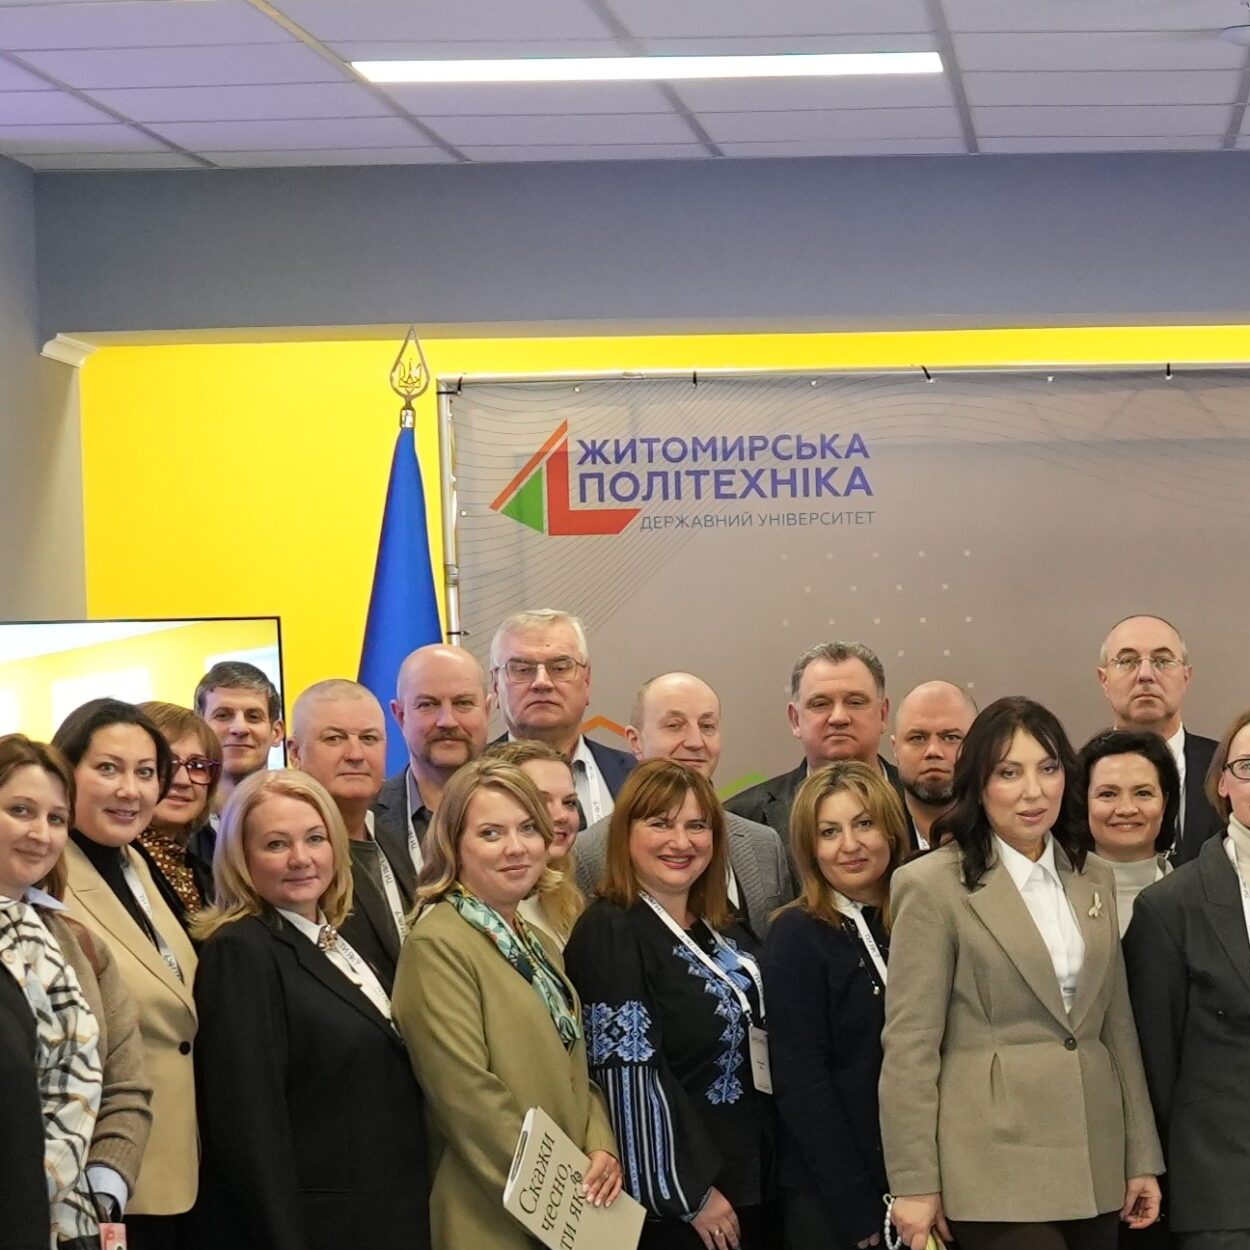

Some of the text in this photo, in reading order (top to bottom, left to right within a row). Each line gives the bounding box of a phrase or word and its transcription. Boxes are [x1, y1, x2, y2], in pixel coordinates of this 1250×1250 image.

[577, 433, 870, 465] ЖИТОМИРСЬКА
[579, 466, 874, 502] ПОЛІТЕХНІКА
[640, 511, 876, 531] ДЕРЖАВНИЙ УНІВЕРСИТЕТ
[519, 1132, 555, 1214] Скажи
[541, 1164, 573, 1231] чесно,
